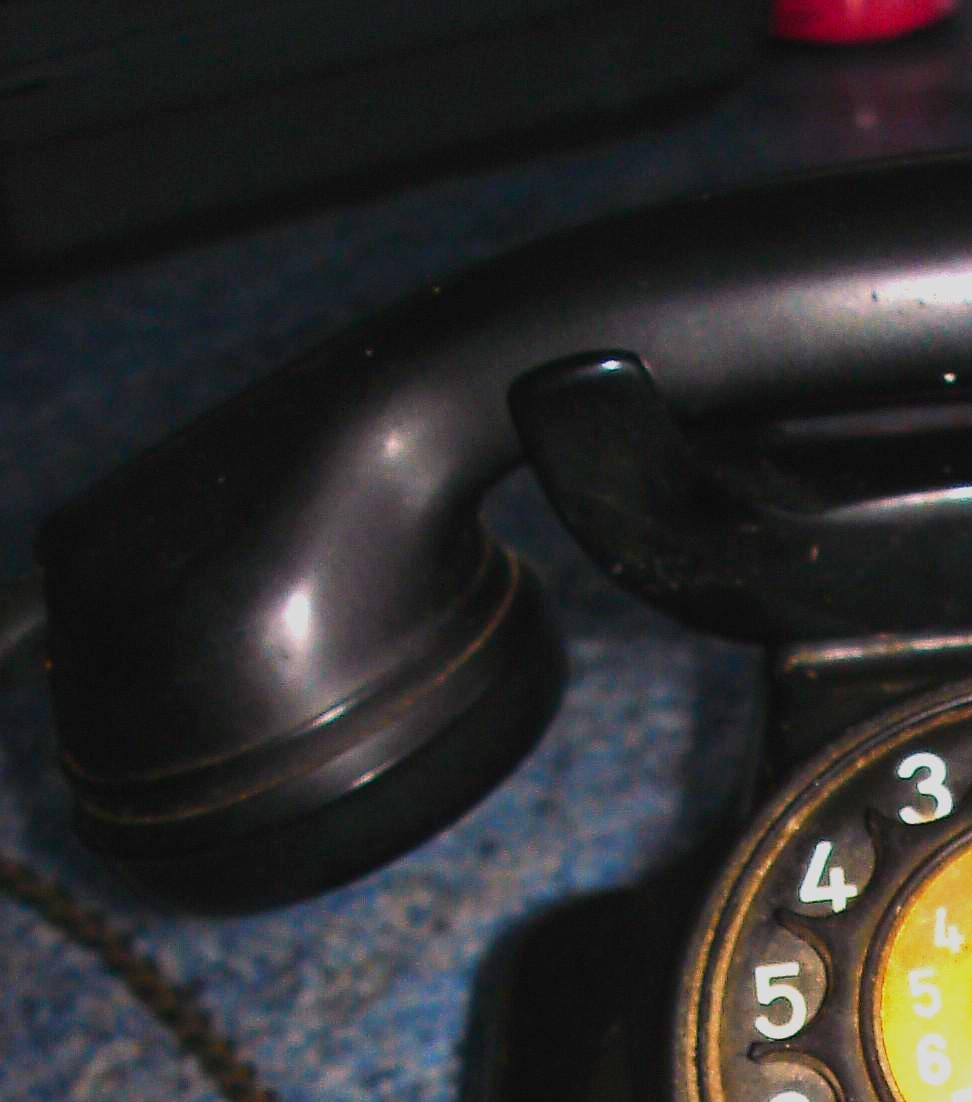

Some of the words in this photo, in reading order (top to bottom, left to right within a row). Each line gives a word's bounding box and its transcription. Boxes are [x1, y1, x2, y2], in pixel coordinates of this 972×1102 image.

[897, 753, 952, 824] 3
[799, 841, 857, 913] 4
[933, 907, 963, 953] 4
[754, 963, 808, 1039] 5
[907, 968, 942, 1018] 5
[916, 1034, 951, 1085] 6
